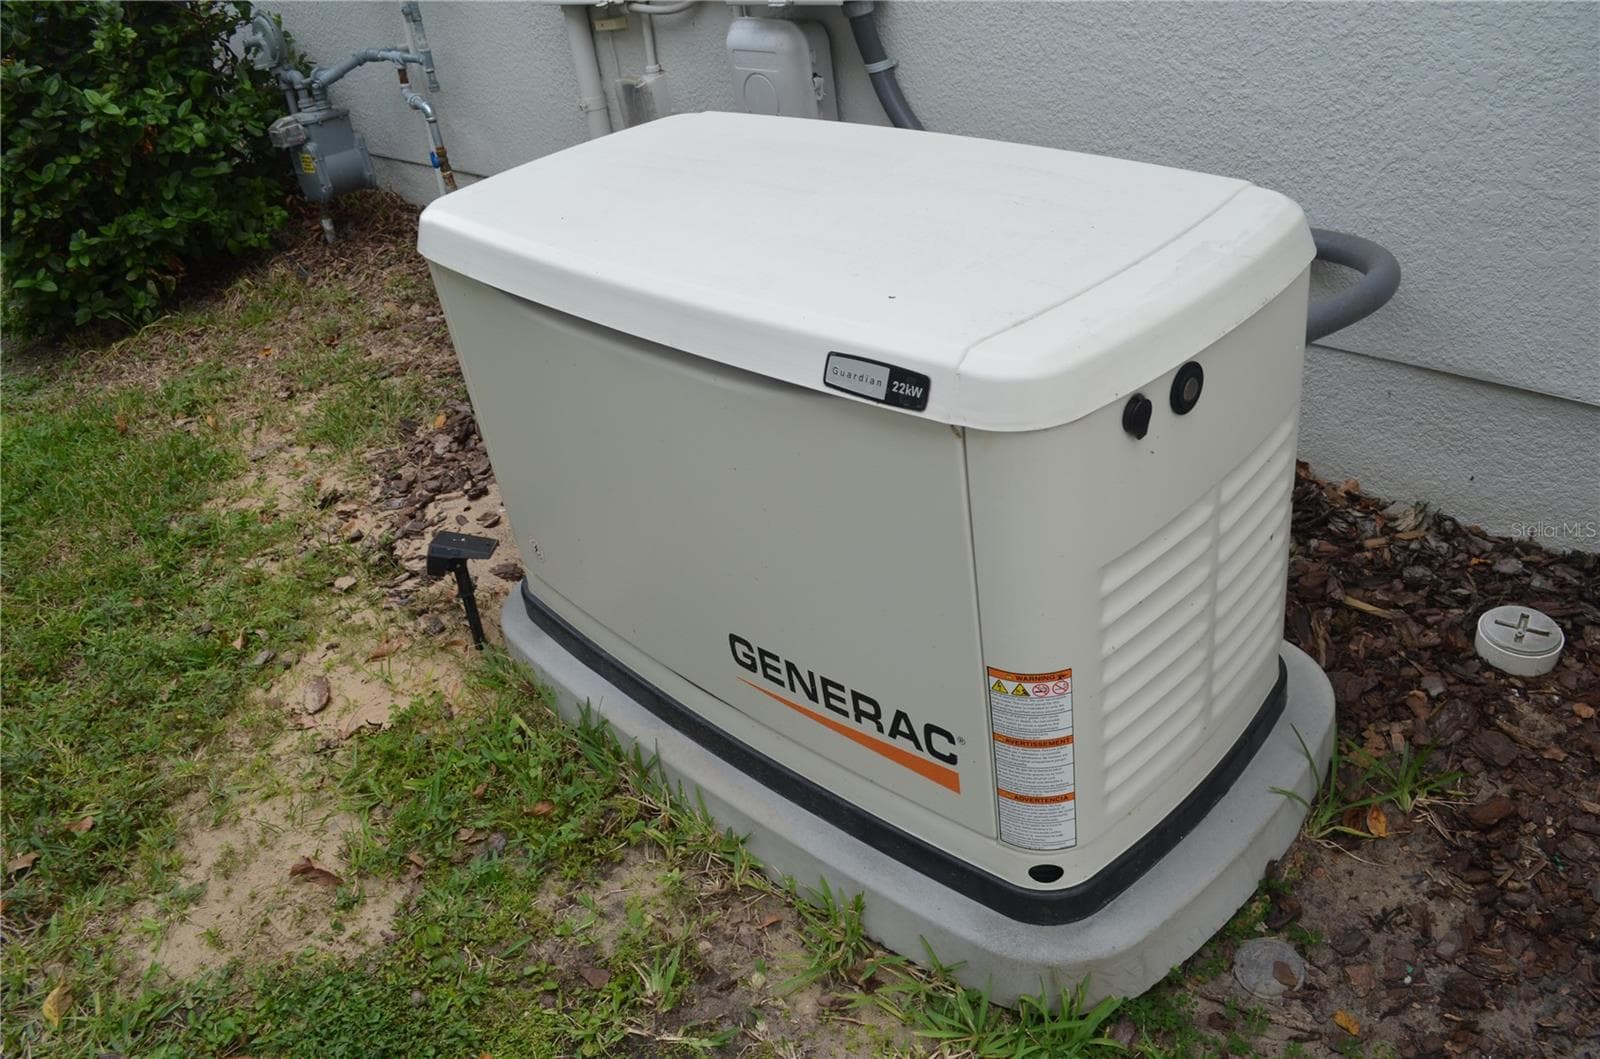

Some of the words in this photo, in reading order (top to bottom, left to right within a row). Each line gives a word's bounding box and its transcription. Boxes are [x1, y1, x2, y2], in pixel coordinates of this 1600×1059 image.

[832, 366, 882, 386] Guardian
[891, 381, 923, 398] 22kW
[1015, 674, 1056, 682] WARNING
[728, 633, 957, 766] GENERAC
[1014, 794, 1067, 803] ADVERTENCIA
